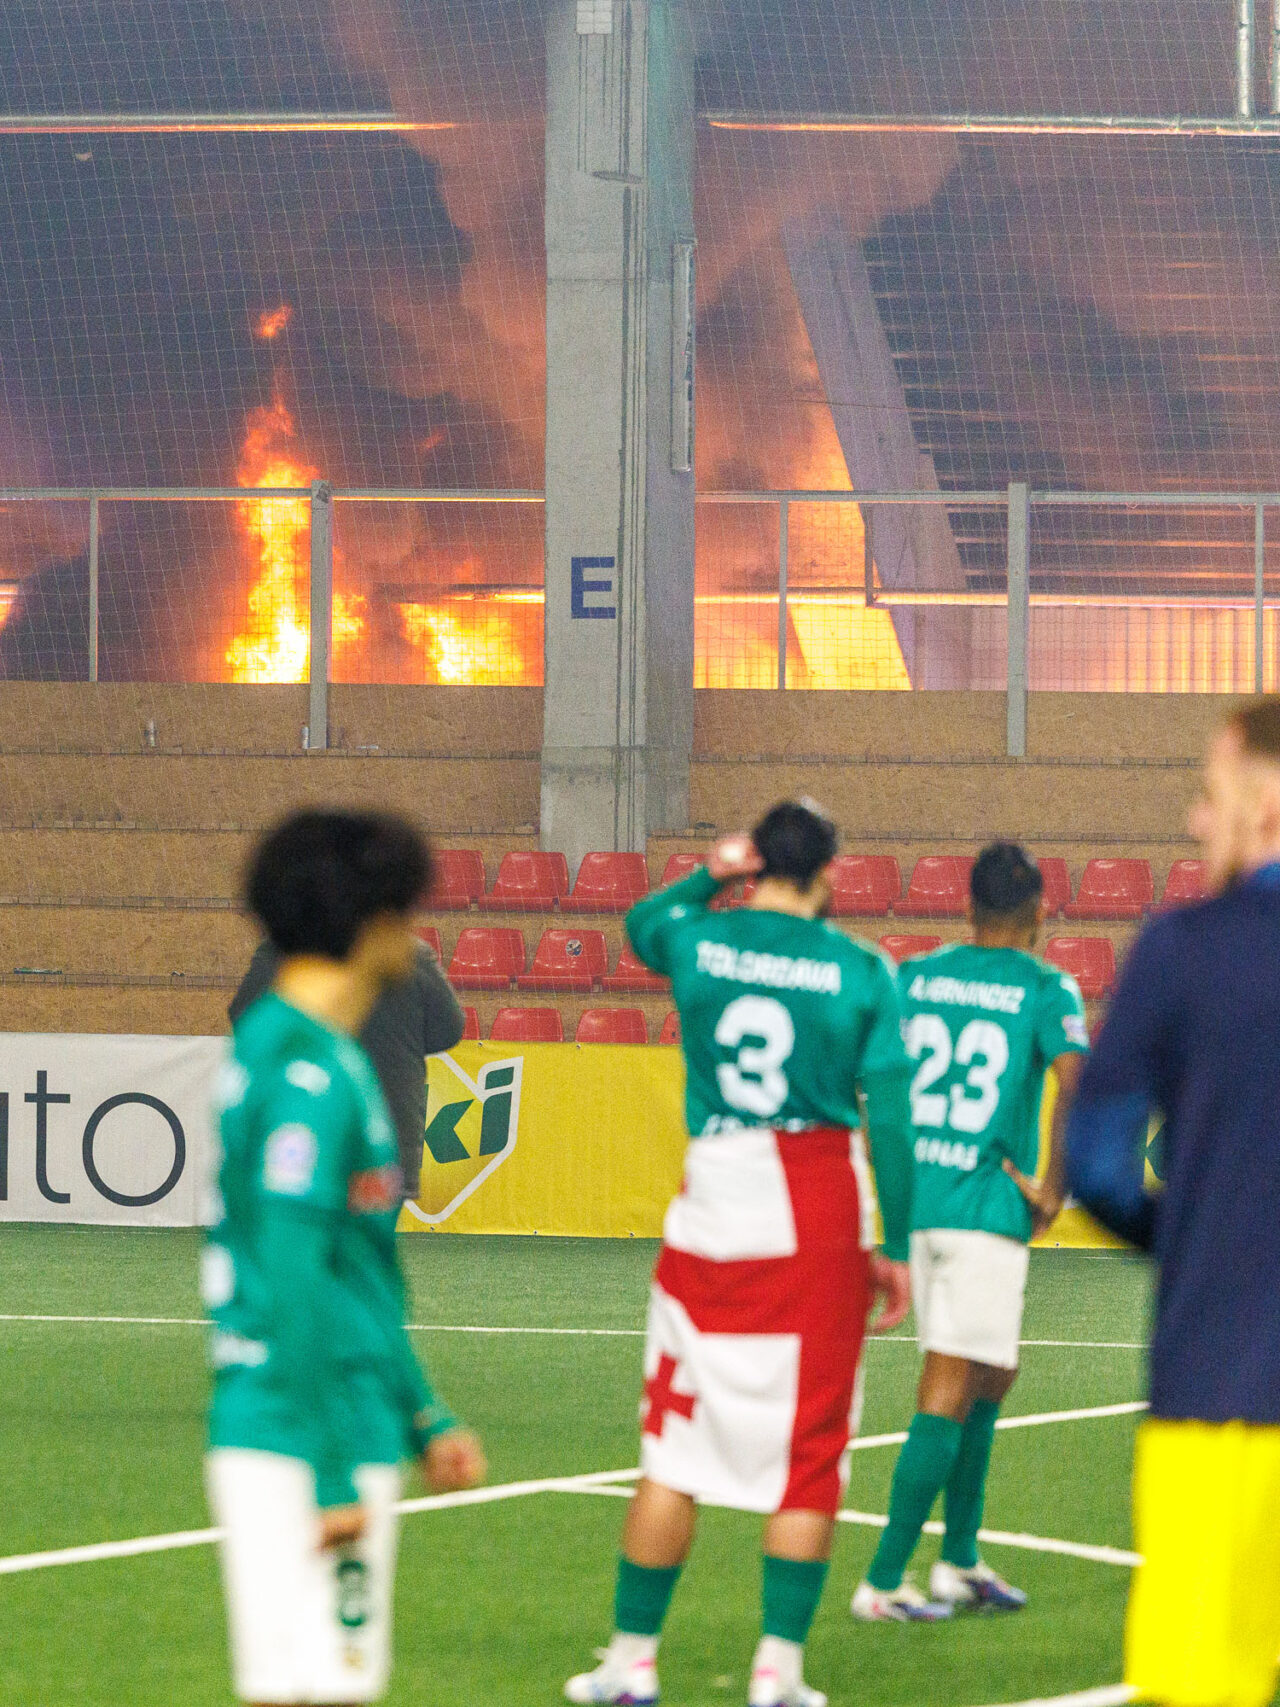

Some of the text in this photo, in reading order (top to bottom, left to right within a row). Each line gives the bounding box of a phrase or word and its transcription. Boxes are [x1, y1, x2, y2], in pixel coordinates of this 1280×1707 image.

[571, 557, 616, 619] E
[714, 994, 795, 1118] 3
[904, 1013, 1009, 1134] 23
